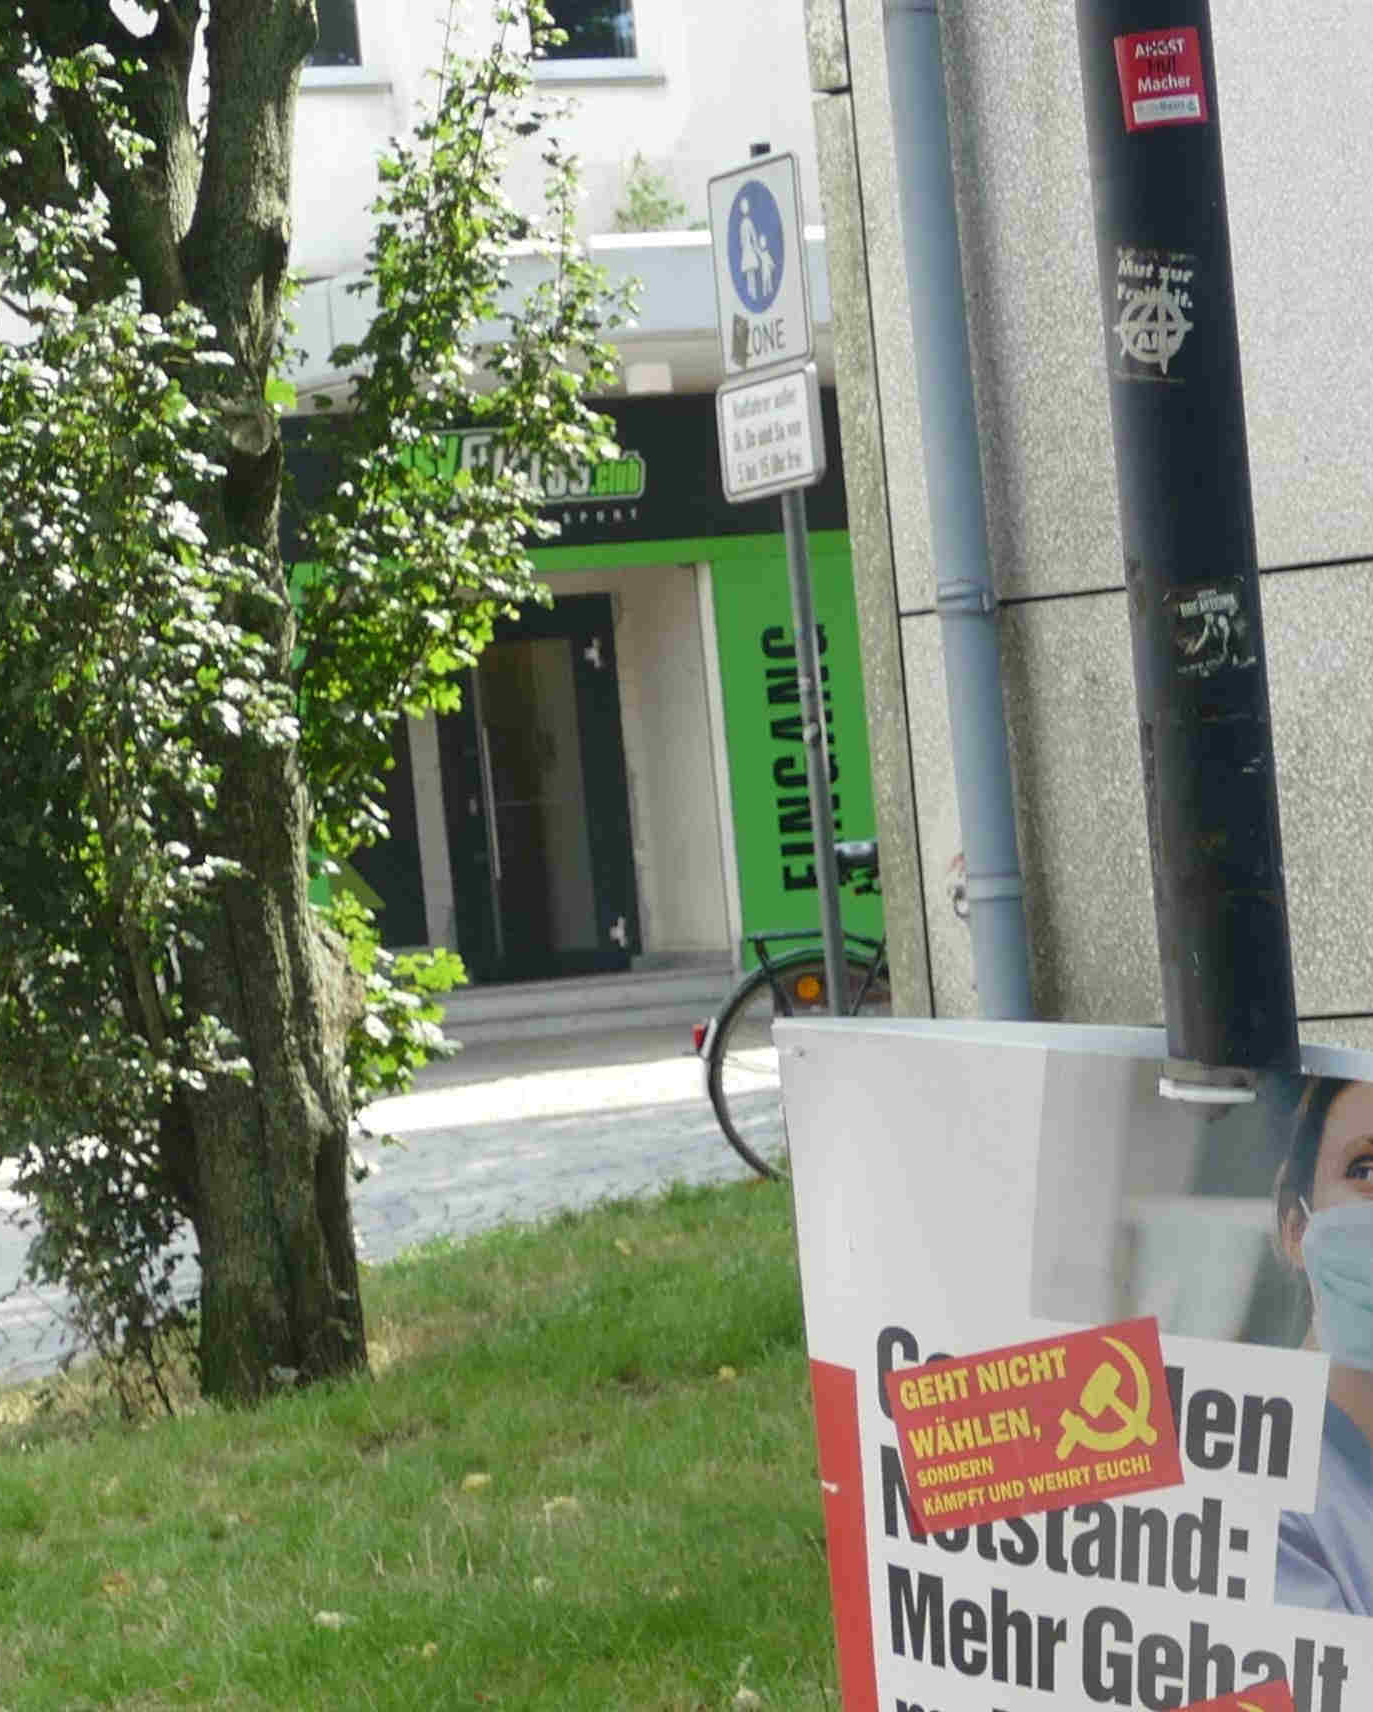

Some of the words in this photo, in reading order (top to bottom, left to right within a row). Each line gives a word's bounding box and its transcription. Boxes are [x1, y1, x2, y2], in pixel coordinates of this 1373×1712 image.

[1137, 73, 1192, 94] Macher
[736, 317, 787, 360] ONE
[899, 1367, 970, 1411] GEHT
[977, 1347, 1067, 1396] NICHT
[908, 1407, 1042, 1460] WÄHLEN,
[917, 1456, 995, 1488] SONDERN
[922, 1485, 986, 1517] KÄMPFT
[988, 1478, 1026, 1503] UND
[1027, 1466, 1091, 1495] WEHRT
[1094, 1454, 1152, 1483] EUCH!
[887, 1562, 1067, 1693] Mehr
